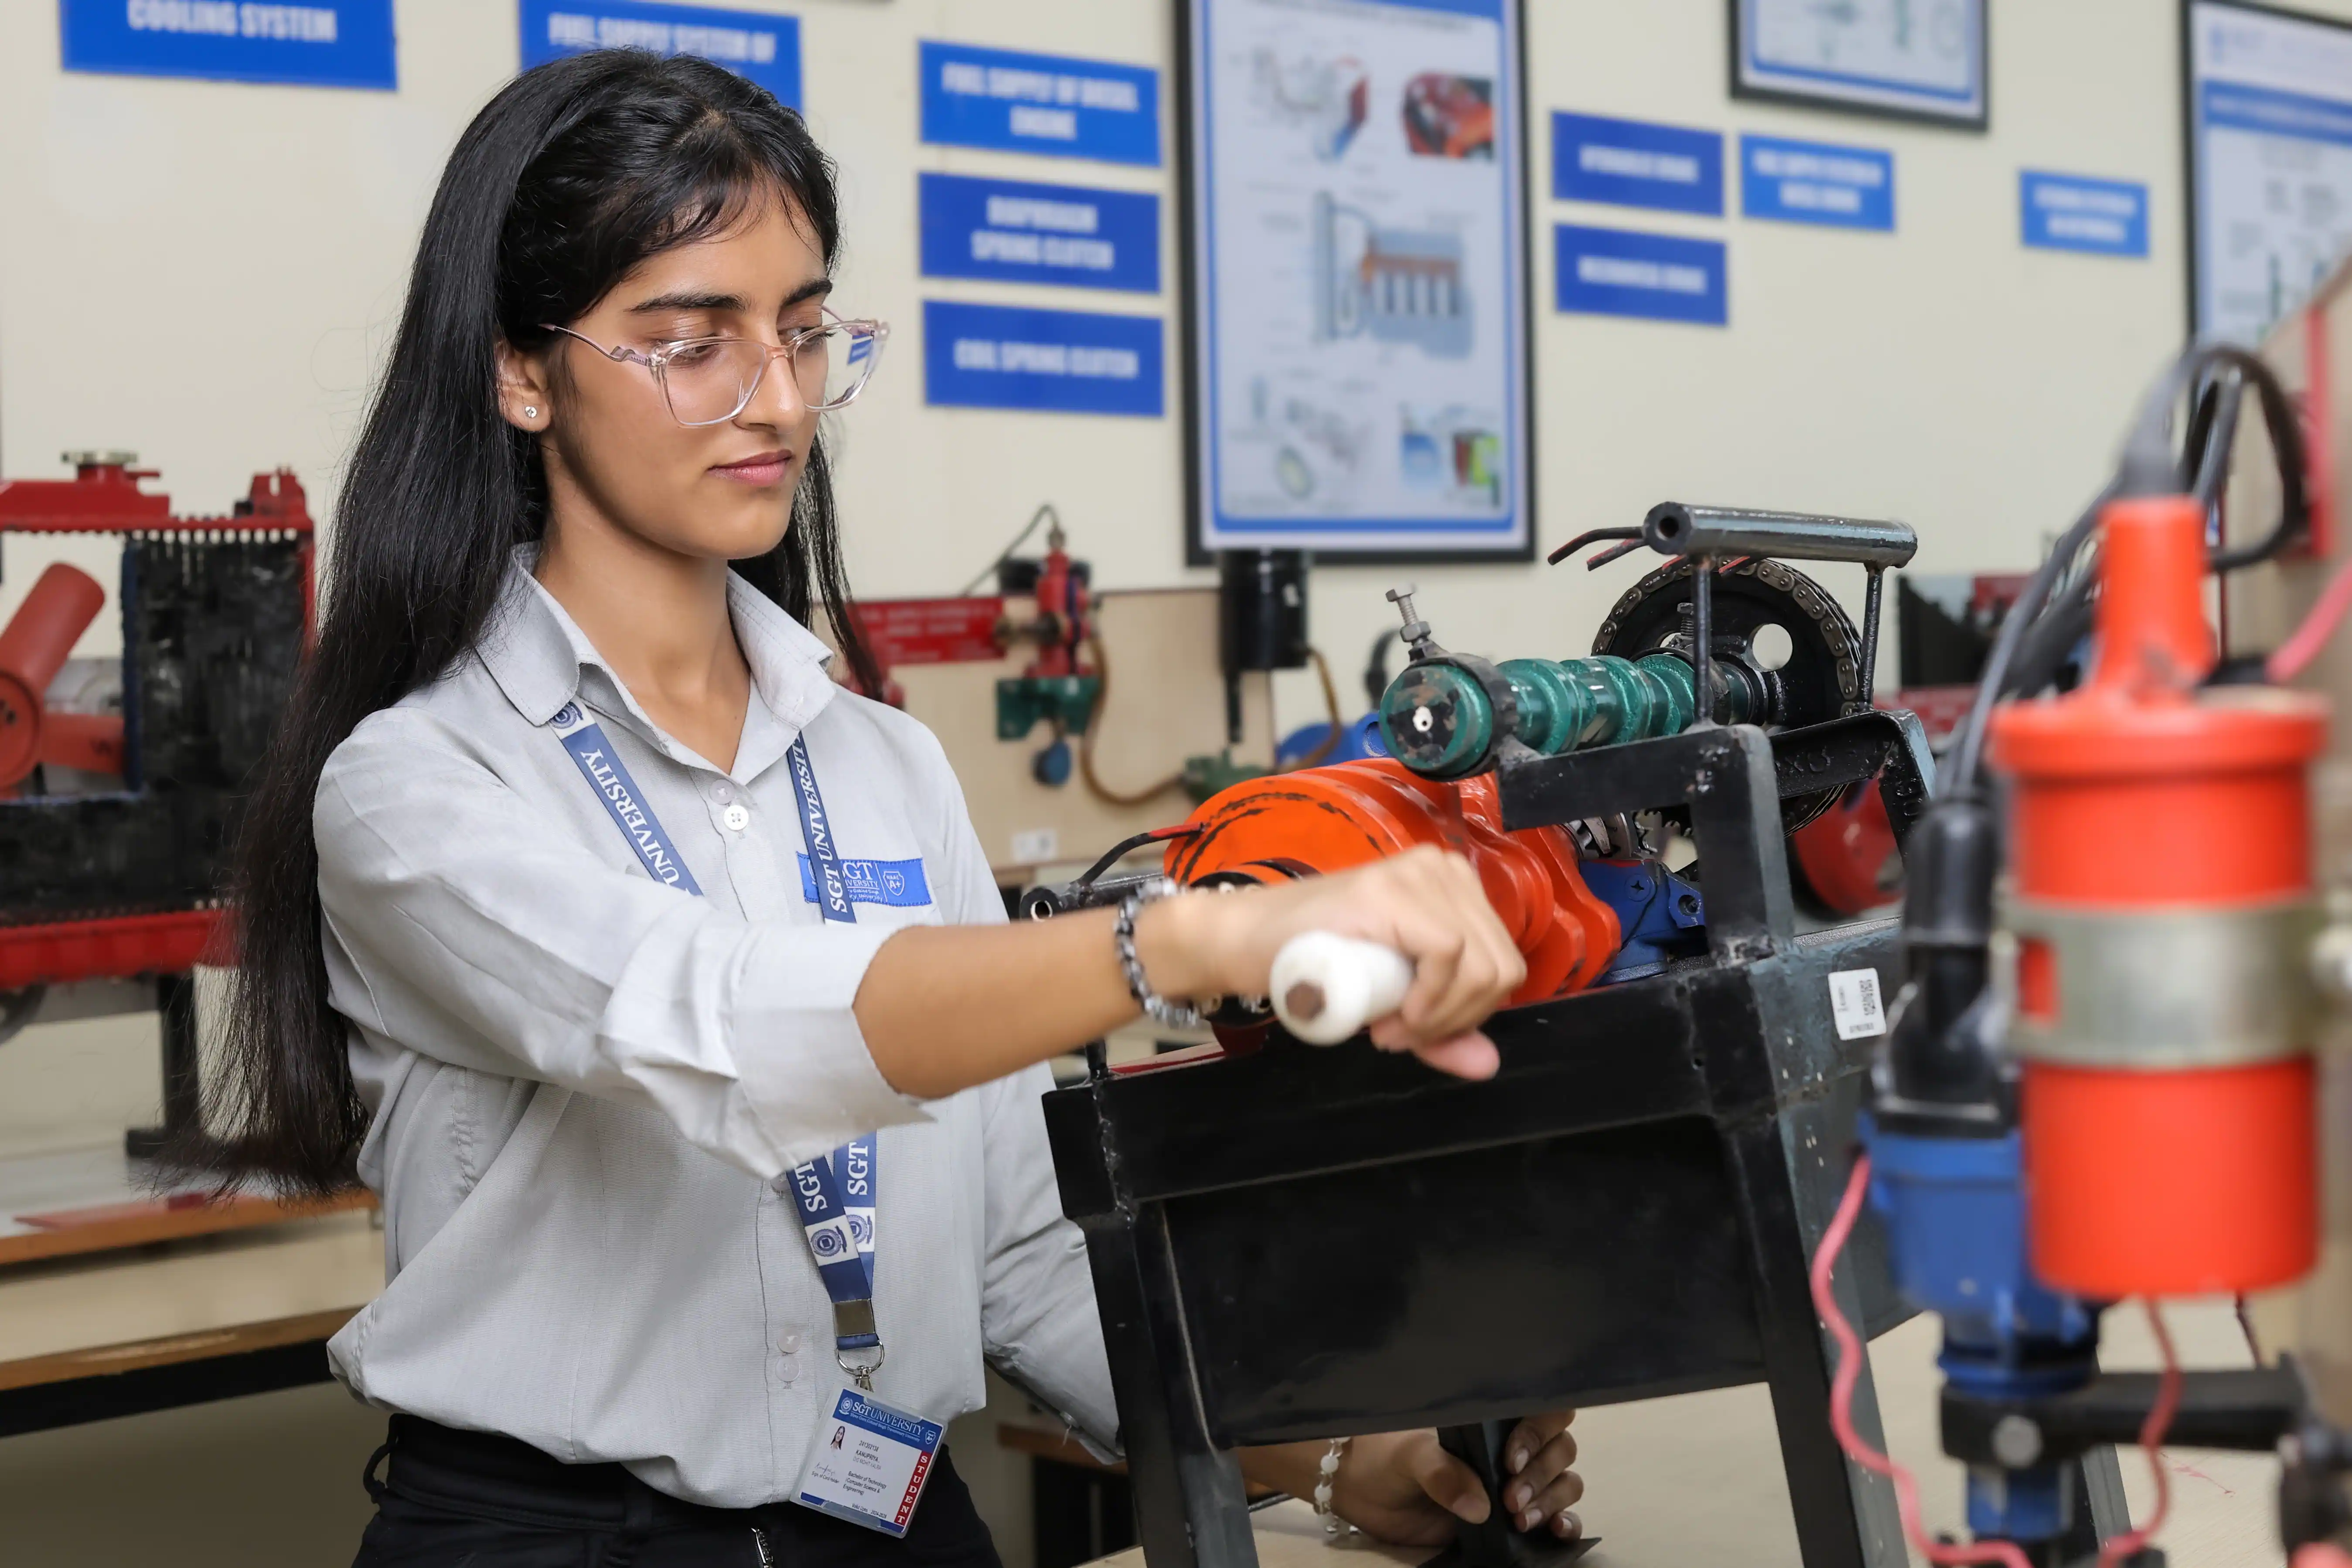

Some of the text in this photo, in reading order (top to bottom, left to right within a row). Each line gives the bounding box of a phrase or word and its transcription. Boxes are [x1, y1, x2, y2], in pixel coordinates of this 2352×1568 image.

[126, 0, 337, 43] COOLING SYSTEM
[580, 748, 680, 886] UNIVERSITY
[842, 862, 873, 880] GT
[845, 879, 878, 888] IVERSITY
[890, 880, 901, 889] A+
[824, 864, 848, 914] SGT
[847, 1142, 868, 1195] SGT
[852, 1401, 924, 1435] SGT UNIVERSITY
[848, 1471, 863, 1480] Bachelor
[867, 1478, 887, 1489] Technology
[863, 1483, 877, 1492] Science
[896, 1455, 928, 1524] STUDENT
